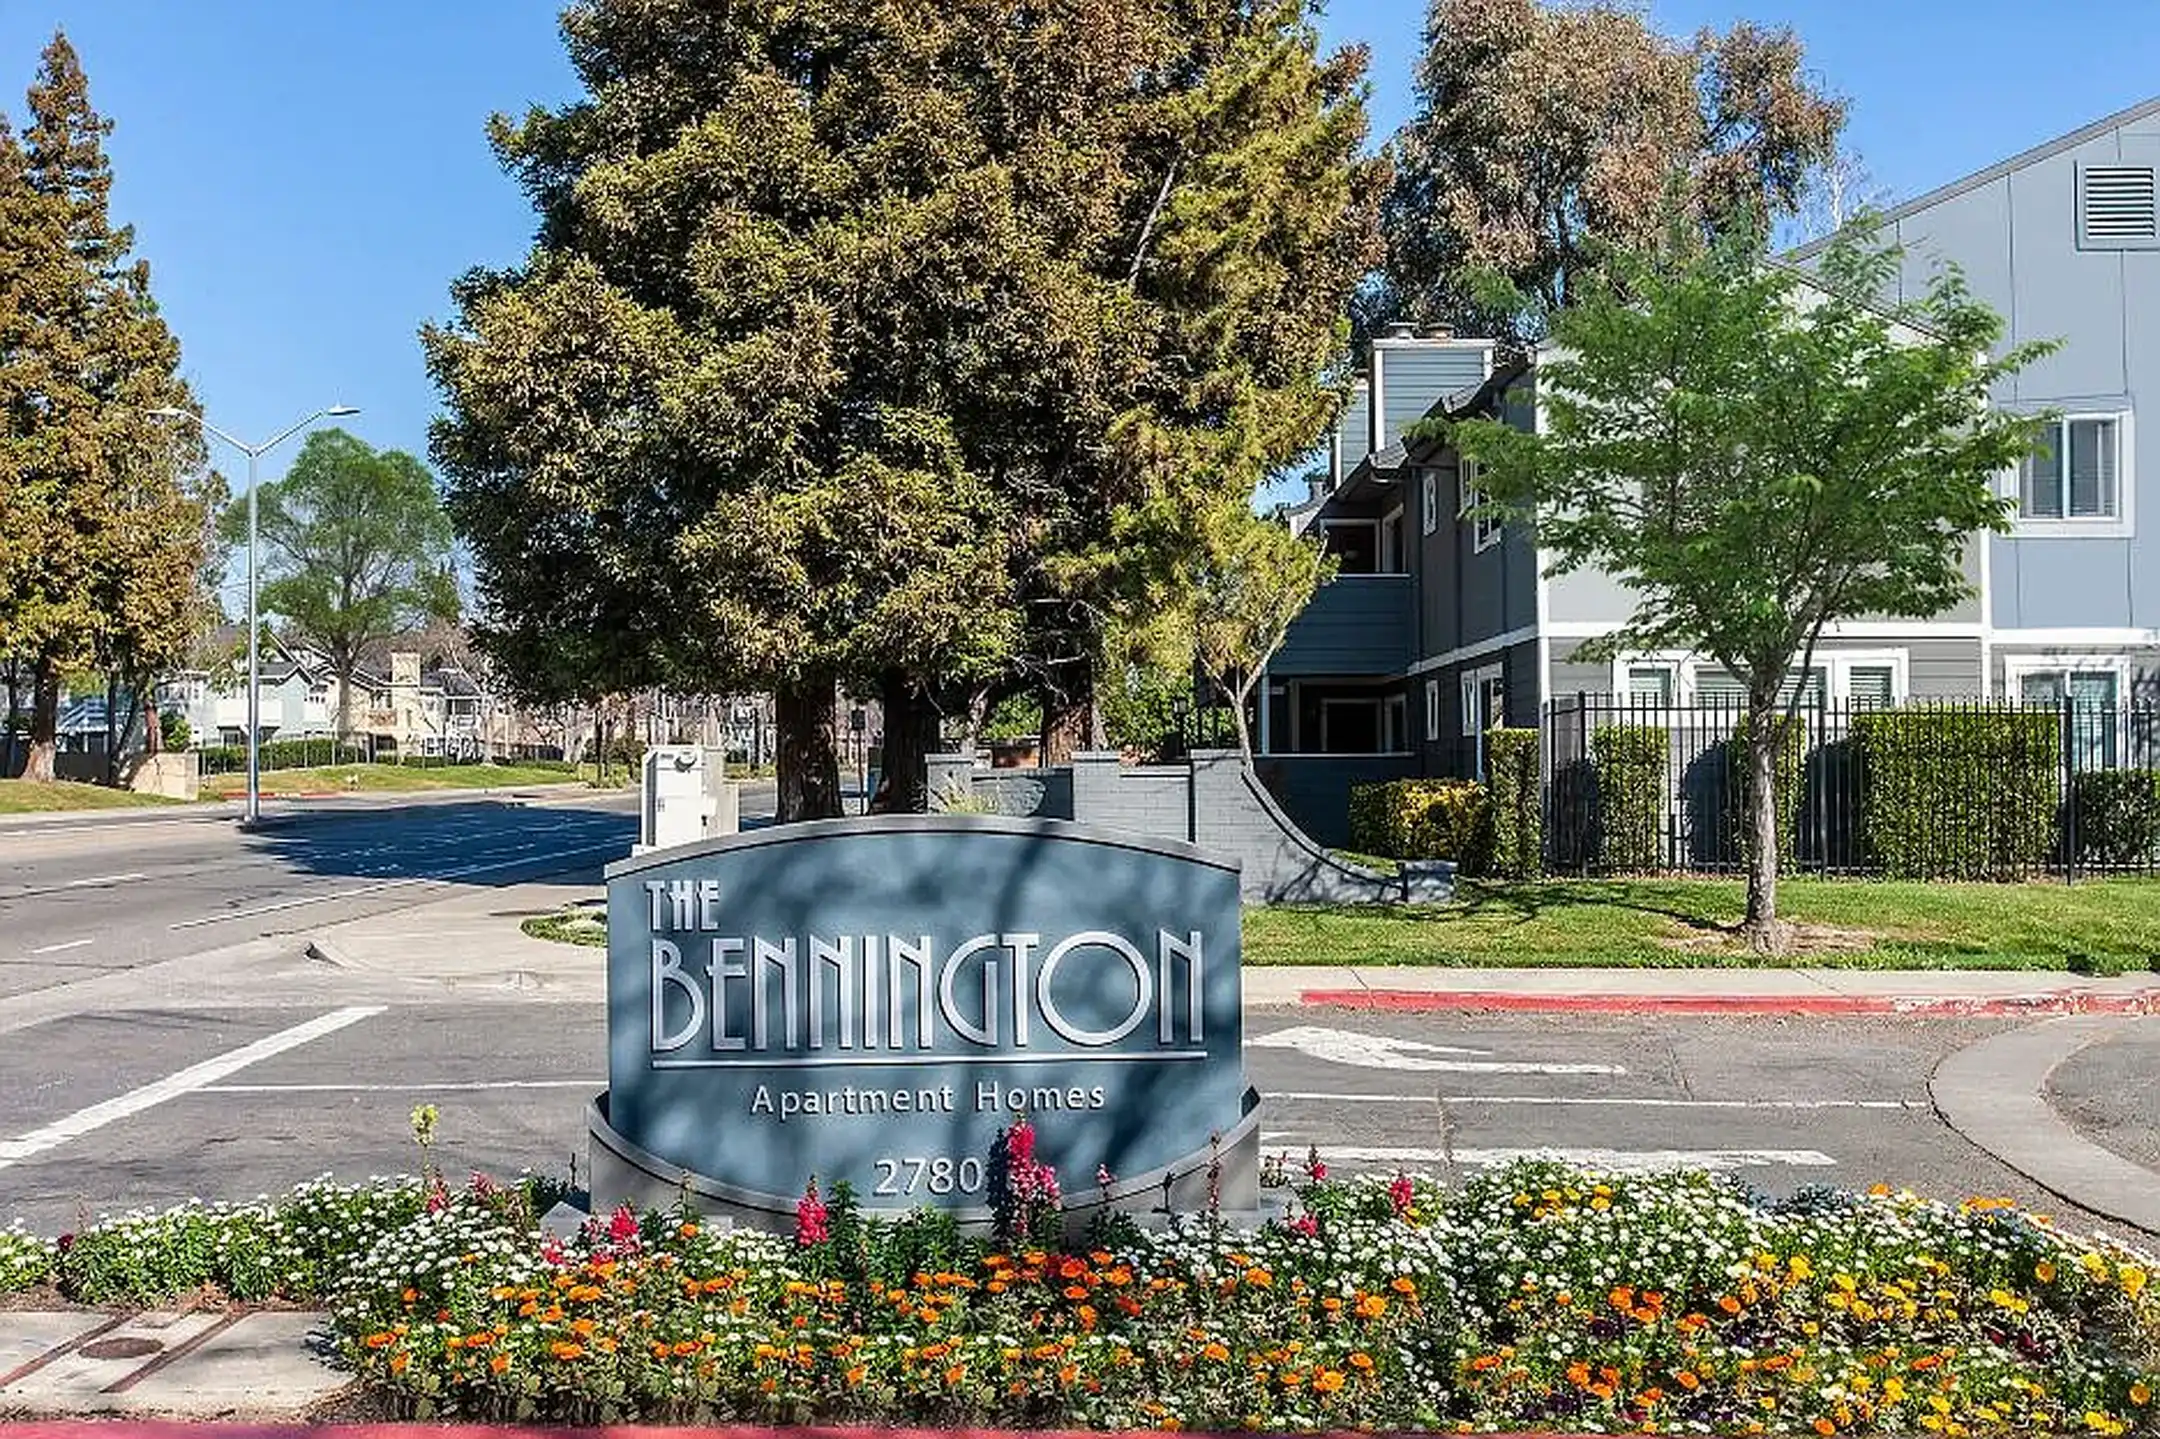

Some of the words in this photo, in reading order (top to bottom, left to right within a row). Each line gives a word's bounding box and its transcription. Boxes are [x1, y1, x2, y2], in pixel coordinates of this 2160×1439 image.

[645, 879, 721, 931] THE
[651, 930, 1204, 1052] BENNINGTON
[751, 1085, 954, 1121] Apartment
[976, 1081, 1106, 1112] Homes
[873, 1156, 983, 1196] 2780
